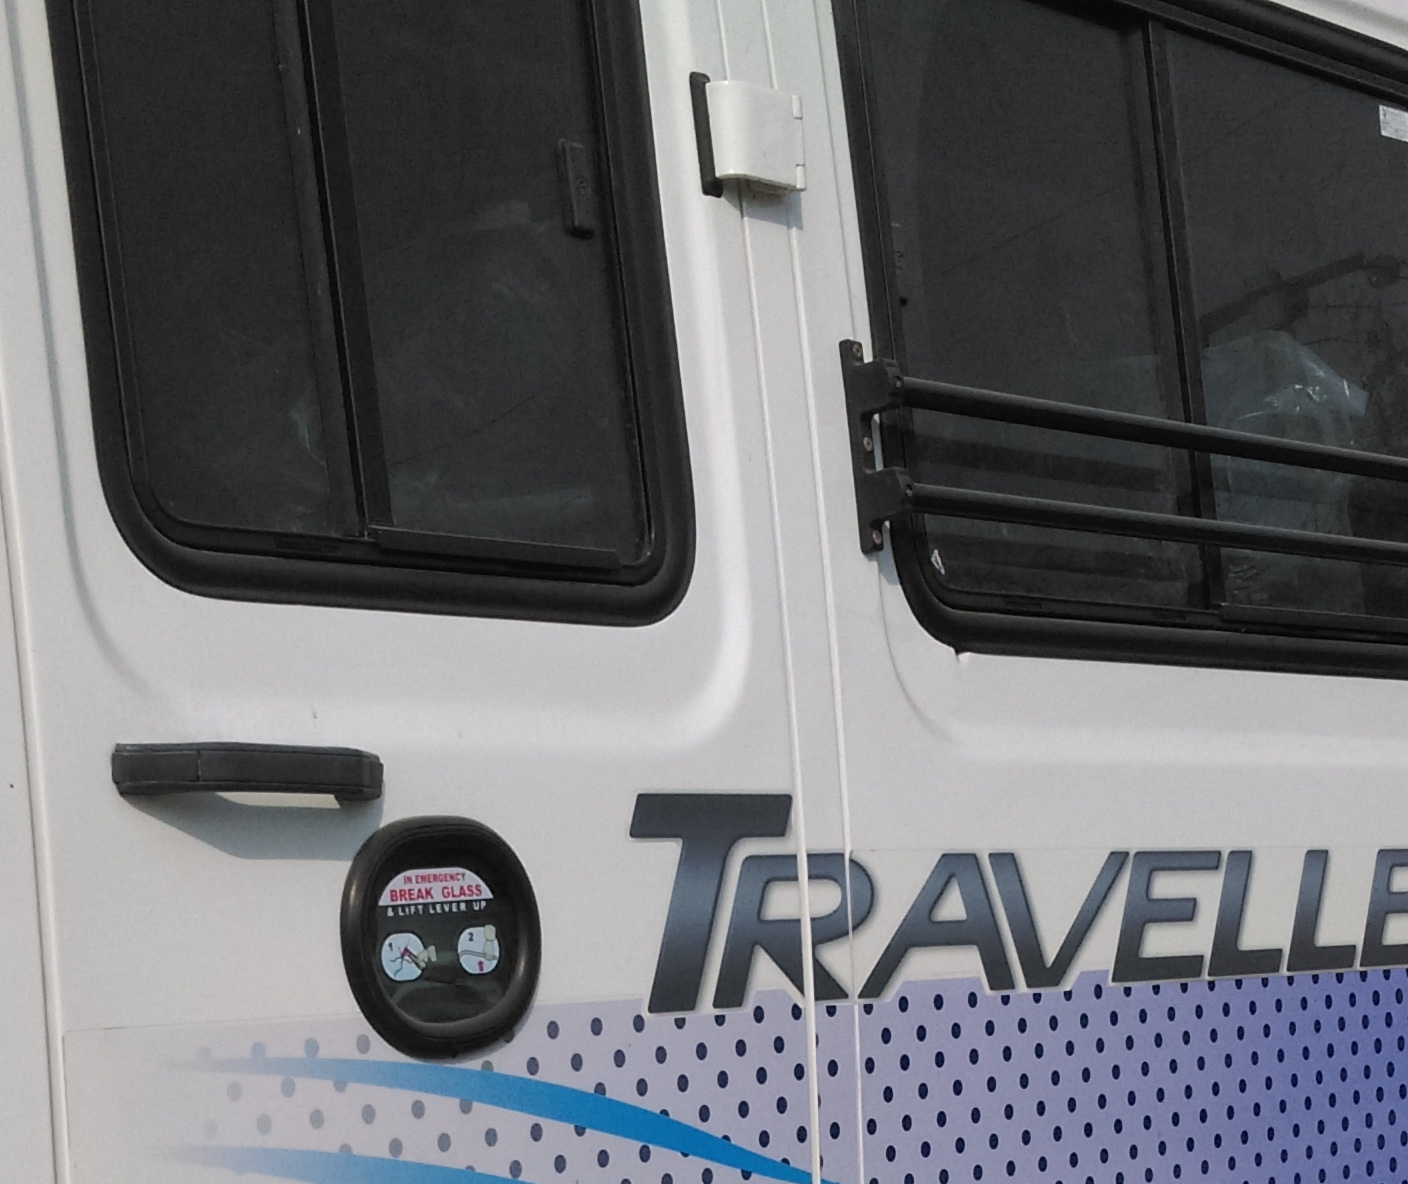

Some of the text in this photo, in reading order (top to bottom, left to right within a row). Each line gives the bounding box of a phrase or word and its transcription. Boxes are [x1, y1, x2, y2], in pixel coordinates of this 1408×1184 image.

[403, 872, 466, 885] IN EMERGENCY
[389, 884, 483, 902] BREAK GLASS
[398, 904, 423, 916] LIFT
[429, 902, 467, 914] LEVER
[473, 901, 487, 911] UP
